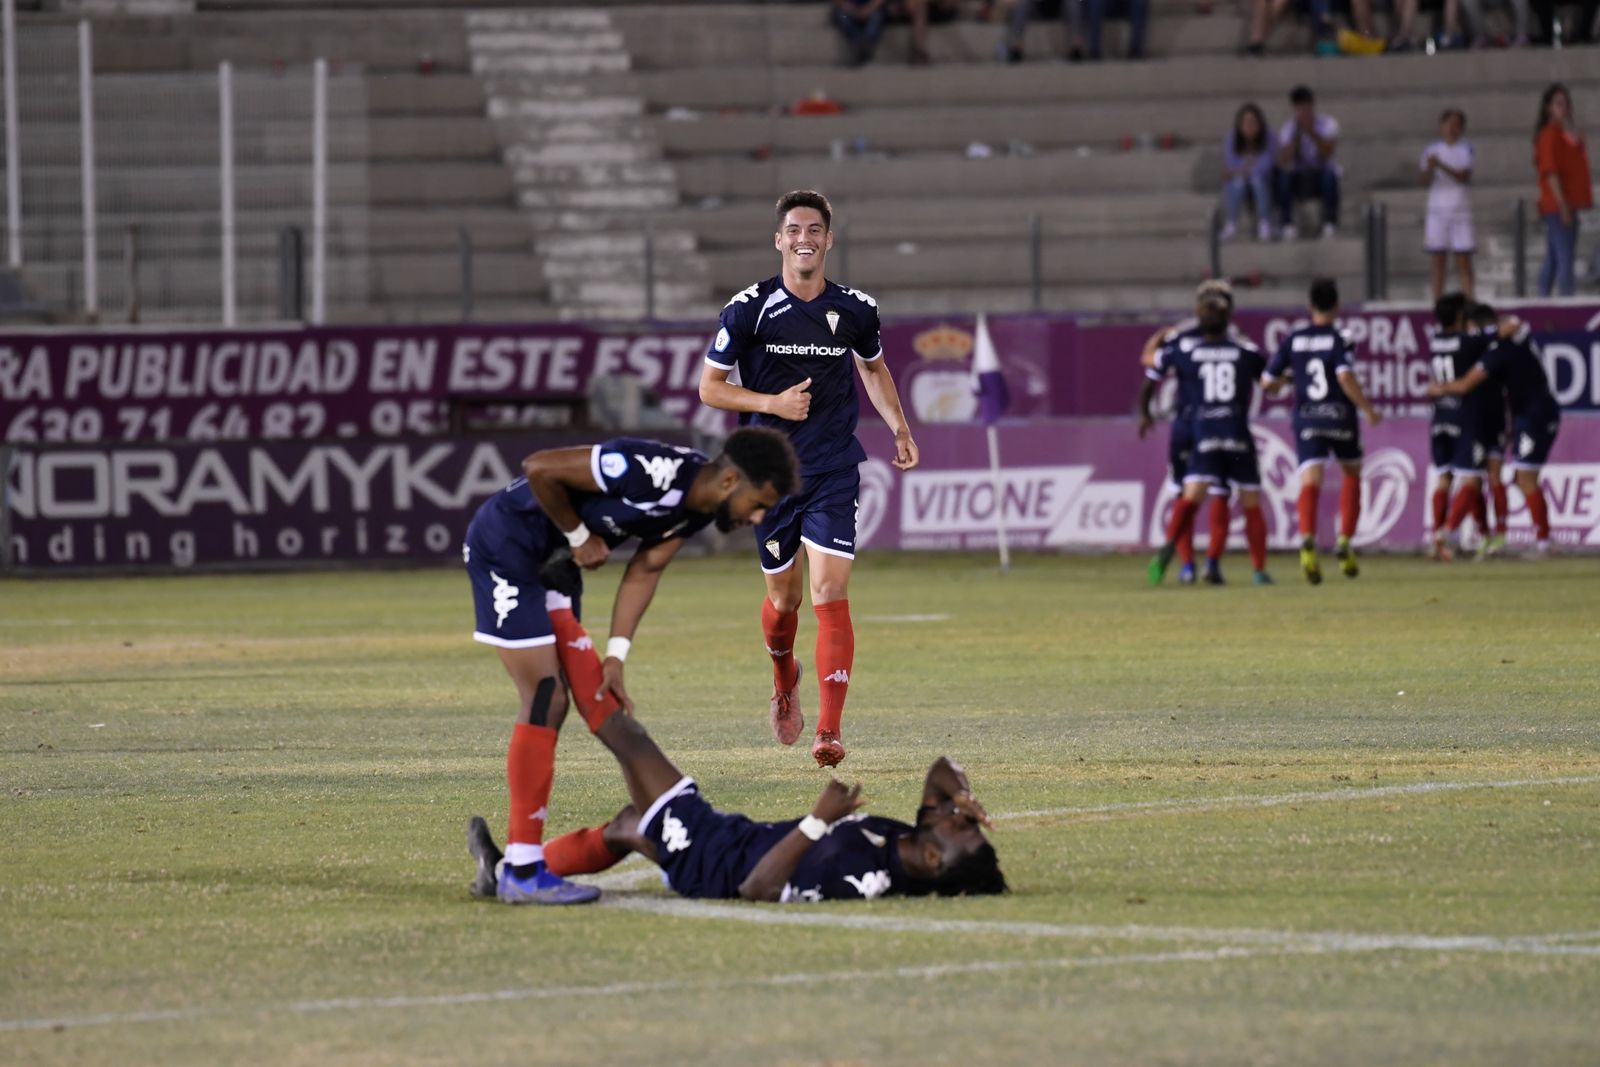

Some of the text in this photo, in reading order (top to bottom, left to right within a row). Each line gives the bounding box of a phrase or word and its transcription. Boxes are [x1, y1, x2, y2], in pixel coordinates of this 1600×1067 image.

[768, 303, 793, 319] Kappa
[765, 343, 847, 357] masterhouse
[1264, 316, 1418, 355] CPRA
[65, 340, 359, 399] PUBLICIDAD
[369, 337, 436, 393] EN
[448, 336, 583, 392] ESTE
[1198, 361, 1237, 402] 18
[1305, 357, 1329, 401] 3
[911, 481, 1056, 521] VITONE
[1078, 500, 1132, 530] ECO
